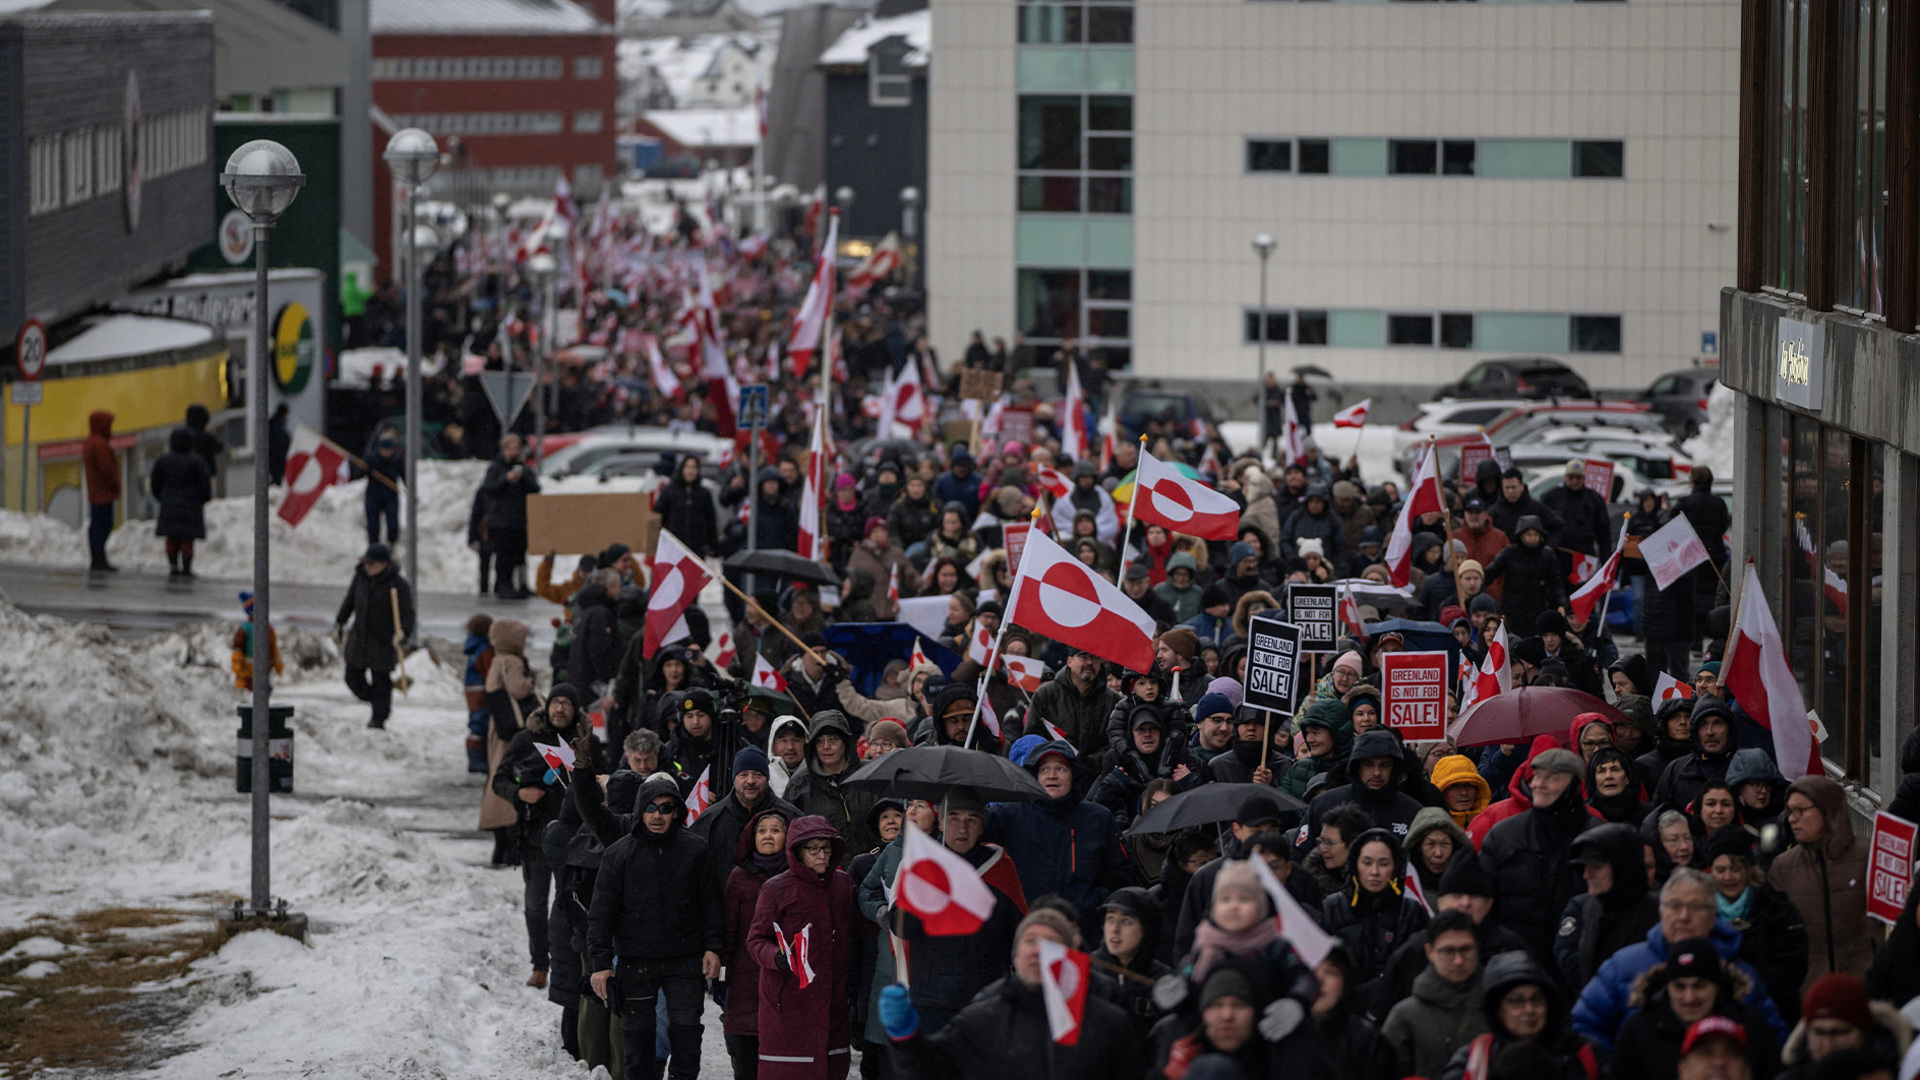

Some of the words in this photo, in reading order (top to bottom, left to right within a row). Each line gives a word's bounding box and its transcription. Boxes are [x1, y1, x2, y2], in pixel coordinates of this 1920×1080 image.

[24, 336, 42, 364] 20
[1295, 597, 1331, 607] GREENLAND
[1295, 610, 1301, 619] IS
[1304, 611, 1316, 619] NOT
[1319, 611, 1331, 619] FOR
[1255, 634, 1293, 652] GREENLAND
[1254, 652, 1261, 663] IS
[1263, 654, 1275, 666] NOT
[1278, 656, 1290, 669] FOR
[1252, 668, 1289, 697] SALE!
[1392, 669, 1439, 681] GREENLAND
[1392, 687, 1400, 698] IS
[1403, 687, 1419, 698] NOT
[1423, 687, 1438, 697] FOR
[1391, 703, 1438, 725] SALE!
